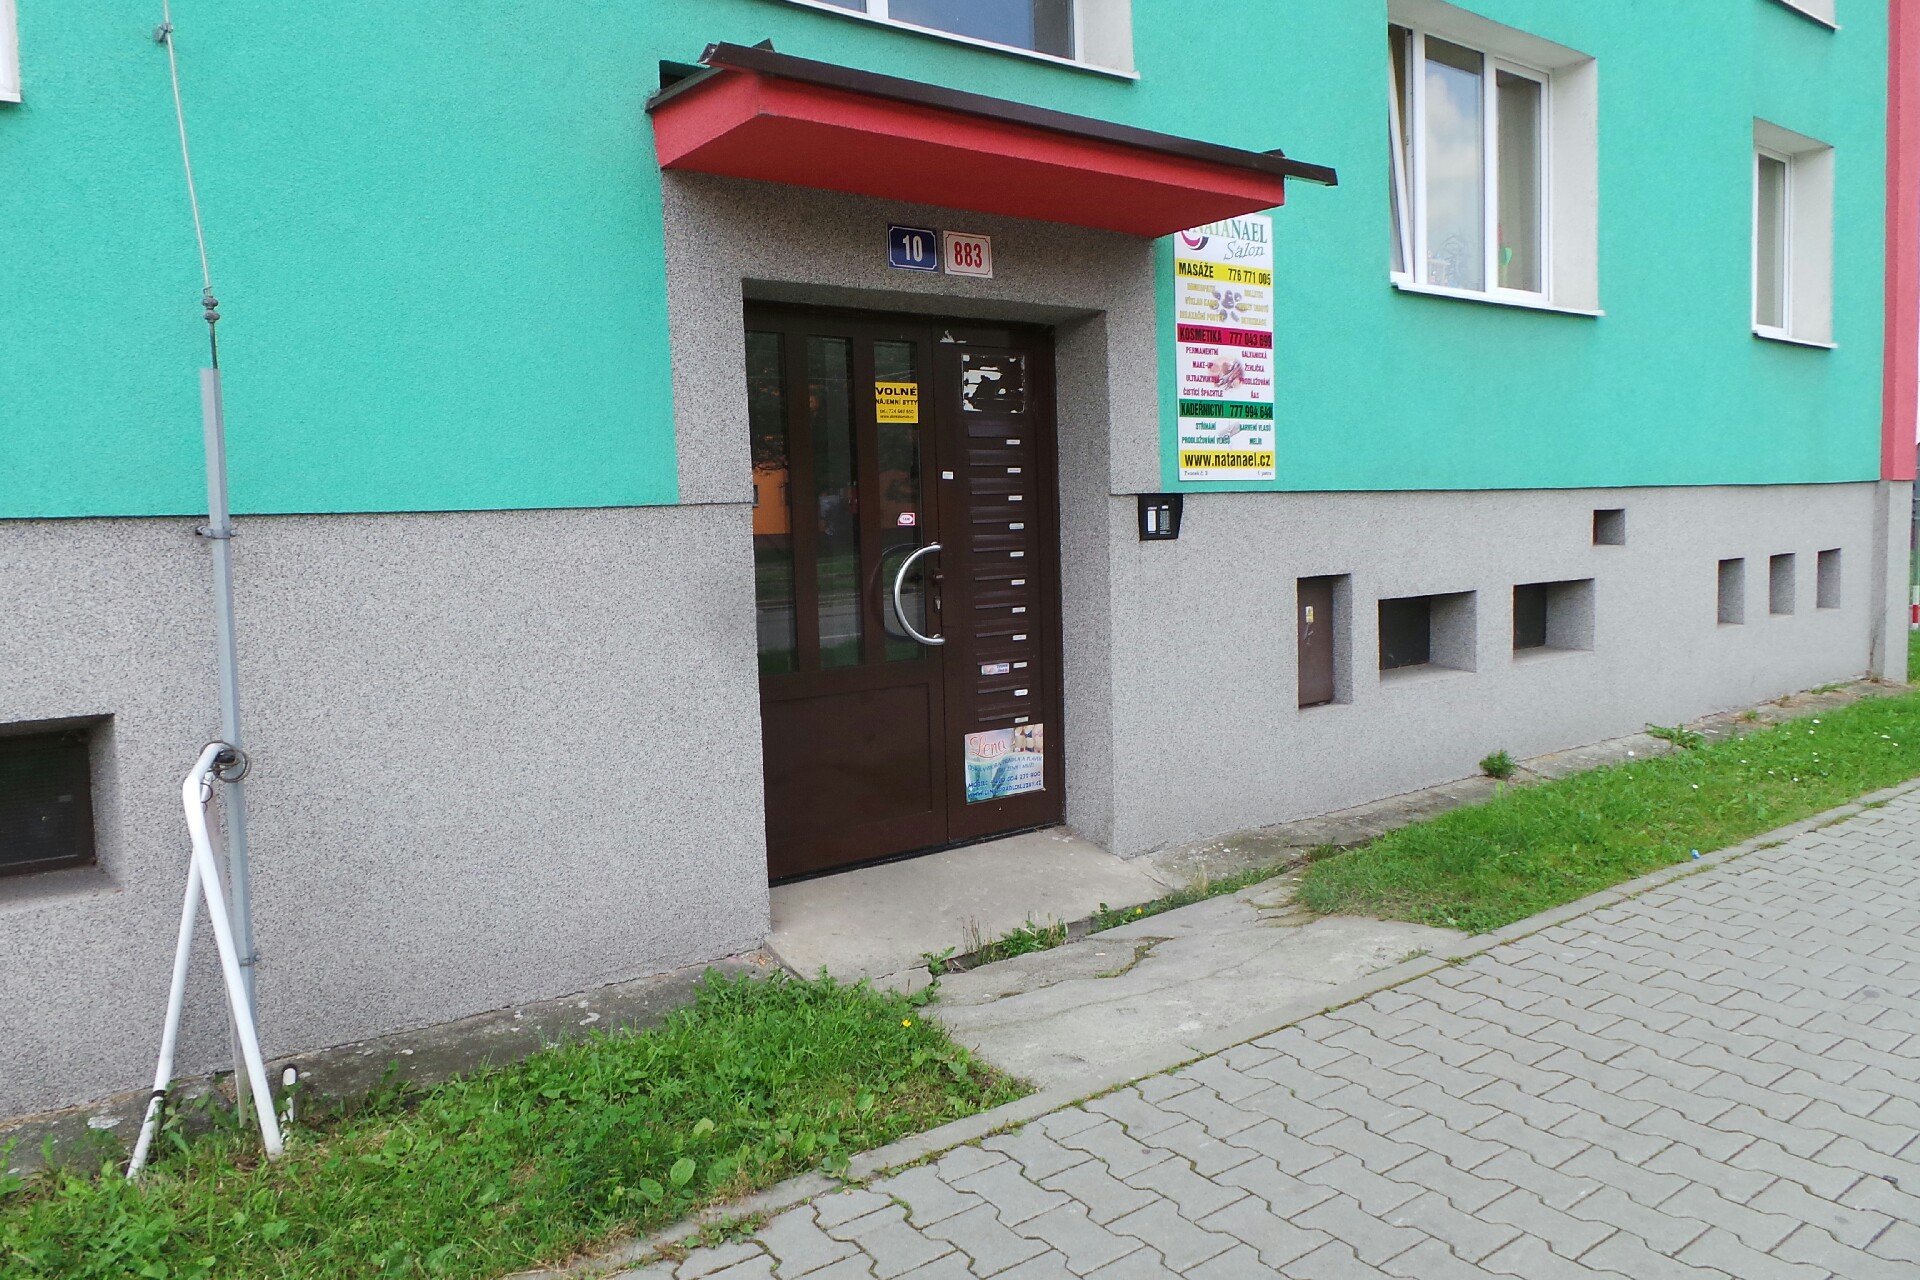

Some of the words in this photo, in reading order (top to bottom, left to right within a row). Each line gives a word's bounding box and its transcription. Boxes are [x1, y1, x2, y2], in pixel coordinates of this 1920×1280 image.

[902, 234, 923, 262] 10
[954, 241, 982, 268] 883
[1224, 241, 1264, 260] Salon
[1178, 261, 1214, 278] MASÁŽE
[1228, 268, 1241, 282] 776
[1243, 270, 1256, 284] 771
[1258, 272, 1271, 286] 005
[1180, 327, 1222, 344] KOSMETIKA
[1229, 331, 1243, 345] 777
[1186, 346, 1219, 355] PERMANENTNÍ
[1193, 361, 1213, 369] MAKE-UP
[875, 386, 917, 396] VOLNÉ
[1201, 388, 1223, 397] ŠPACHTLE
[1181, 401, 1224, 417] KADEŘNICTVÍ
[1230, 404, 1243, 417] 777
[1245, 405, 1258, 418] 994
[1184, 452, 1271, 467] www.natanael.cz
